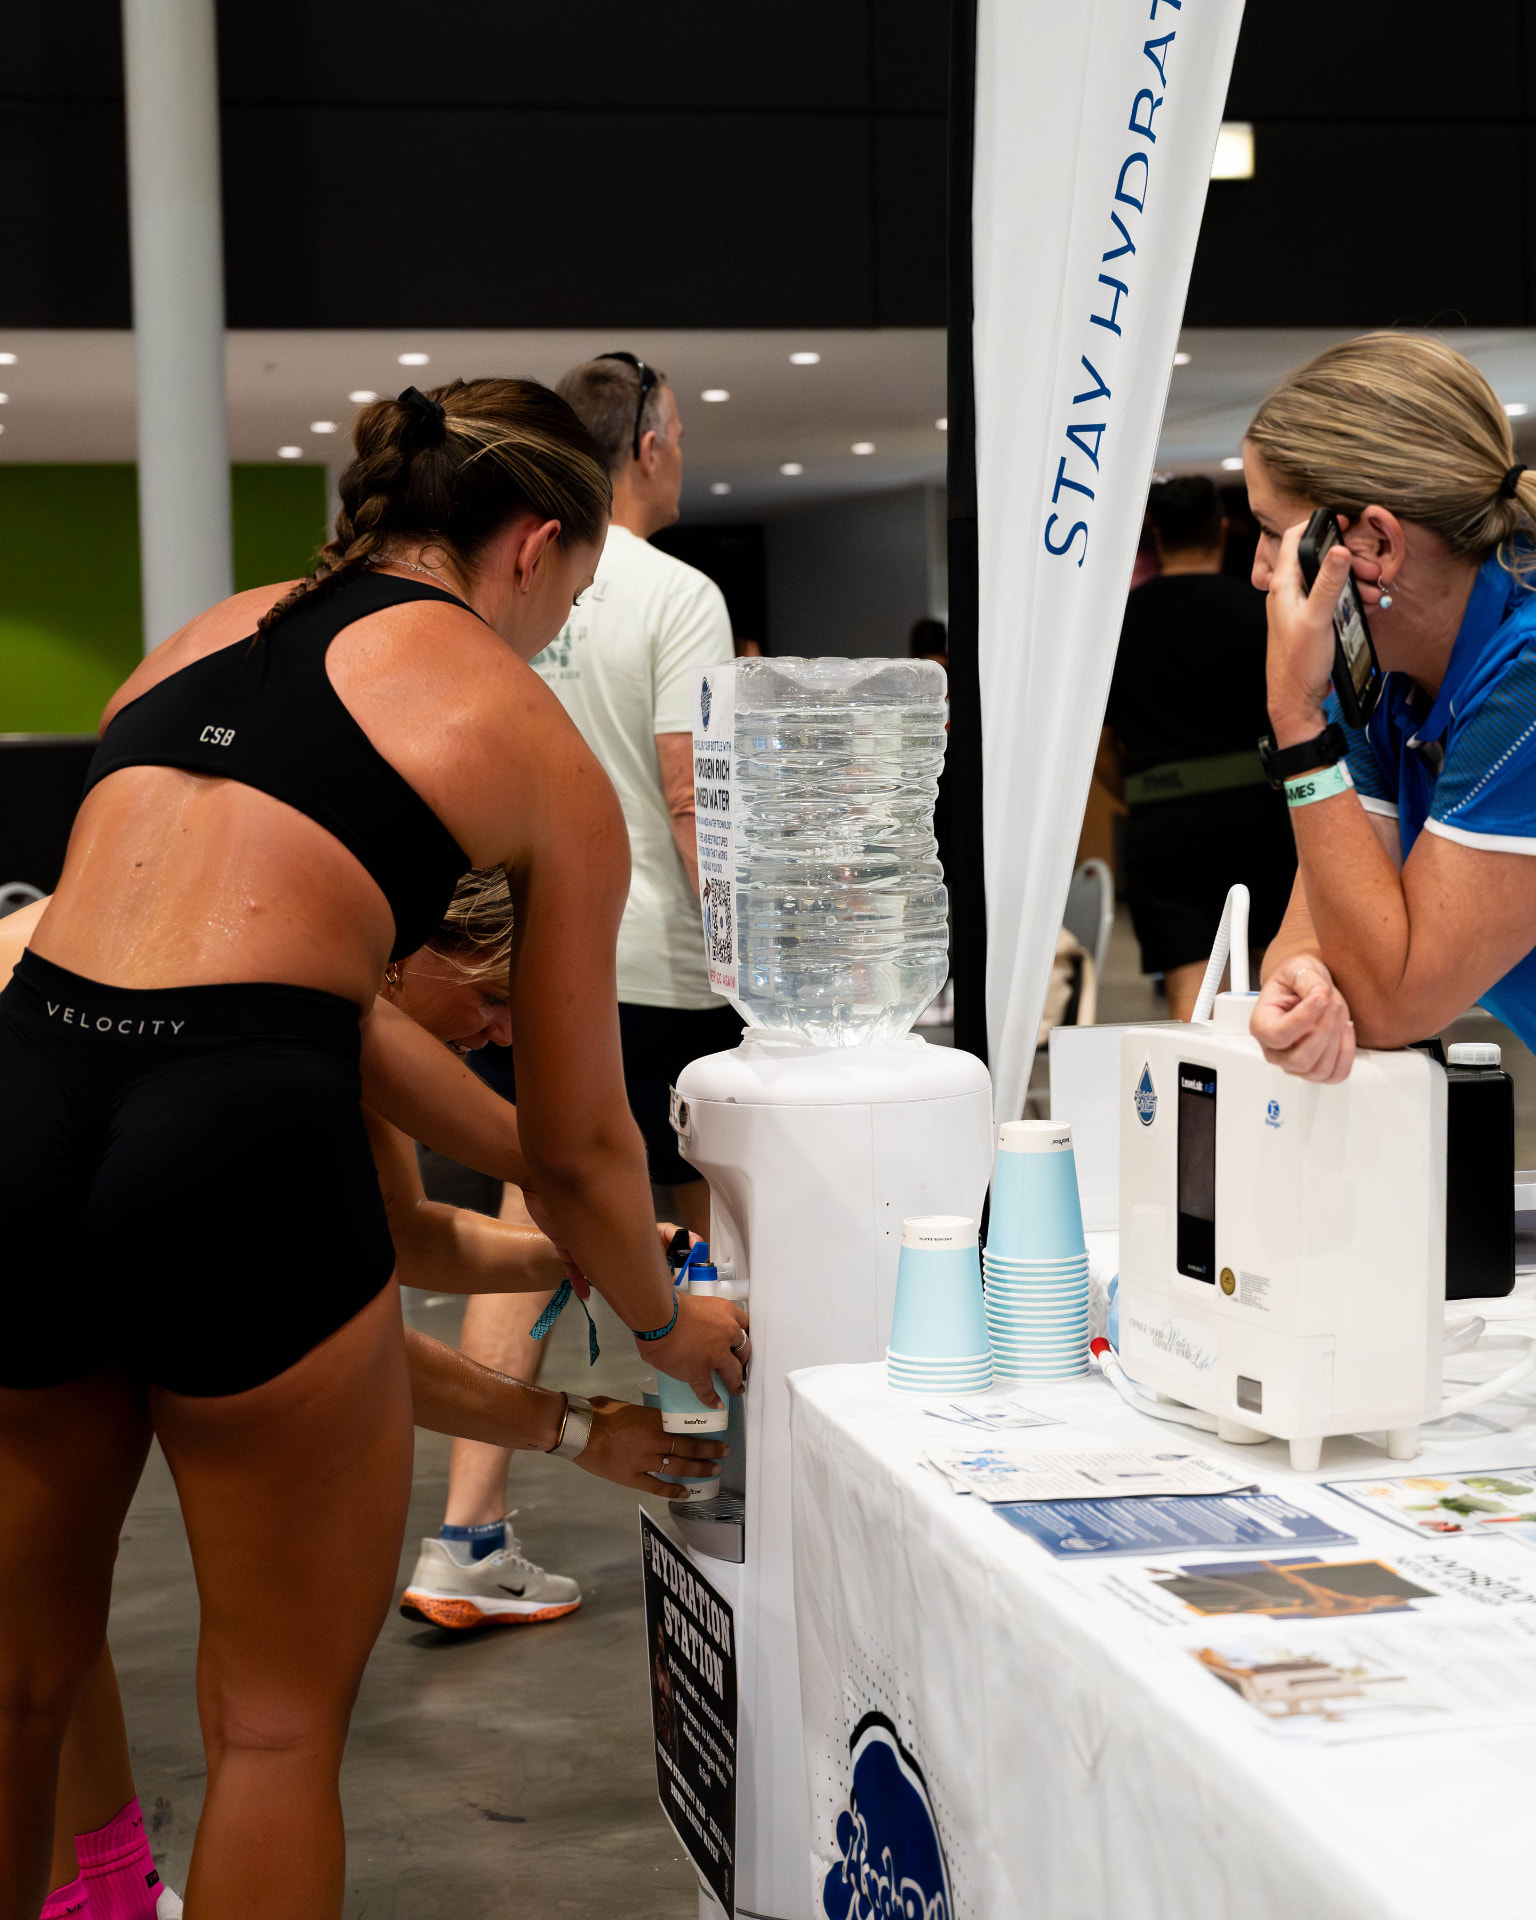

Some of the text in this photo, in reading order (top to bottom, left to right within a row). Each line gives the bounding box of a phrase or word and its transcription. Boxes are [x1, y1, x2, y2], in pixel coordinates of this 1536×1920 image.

[1043, 355, 1113, 569] STAY
[199, 724, 237, 749] CSB
[715, 759, 730, 781] RICH
[709, 788, 730, 812] WATER
[45, 1000, 188, 1037] VELOCITY
[650, 1533, 731, 1657] HYDRATION
[664, 1596, 723, 1700] STATION
[669, 1654, 684, 1684] Hydrate
[702, 1696, 720, 1729] Recover
